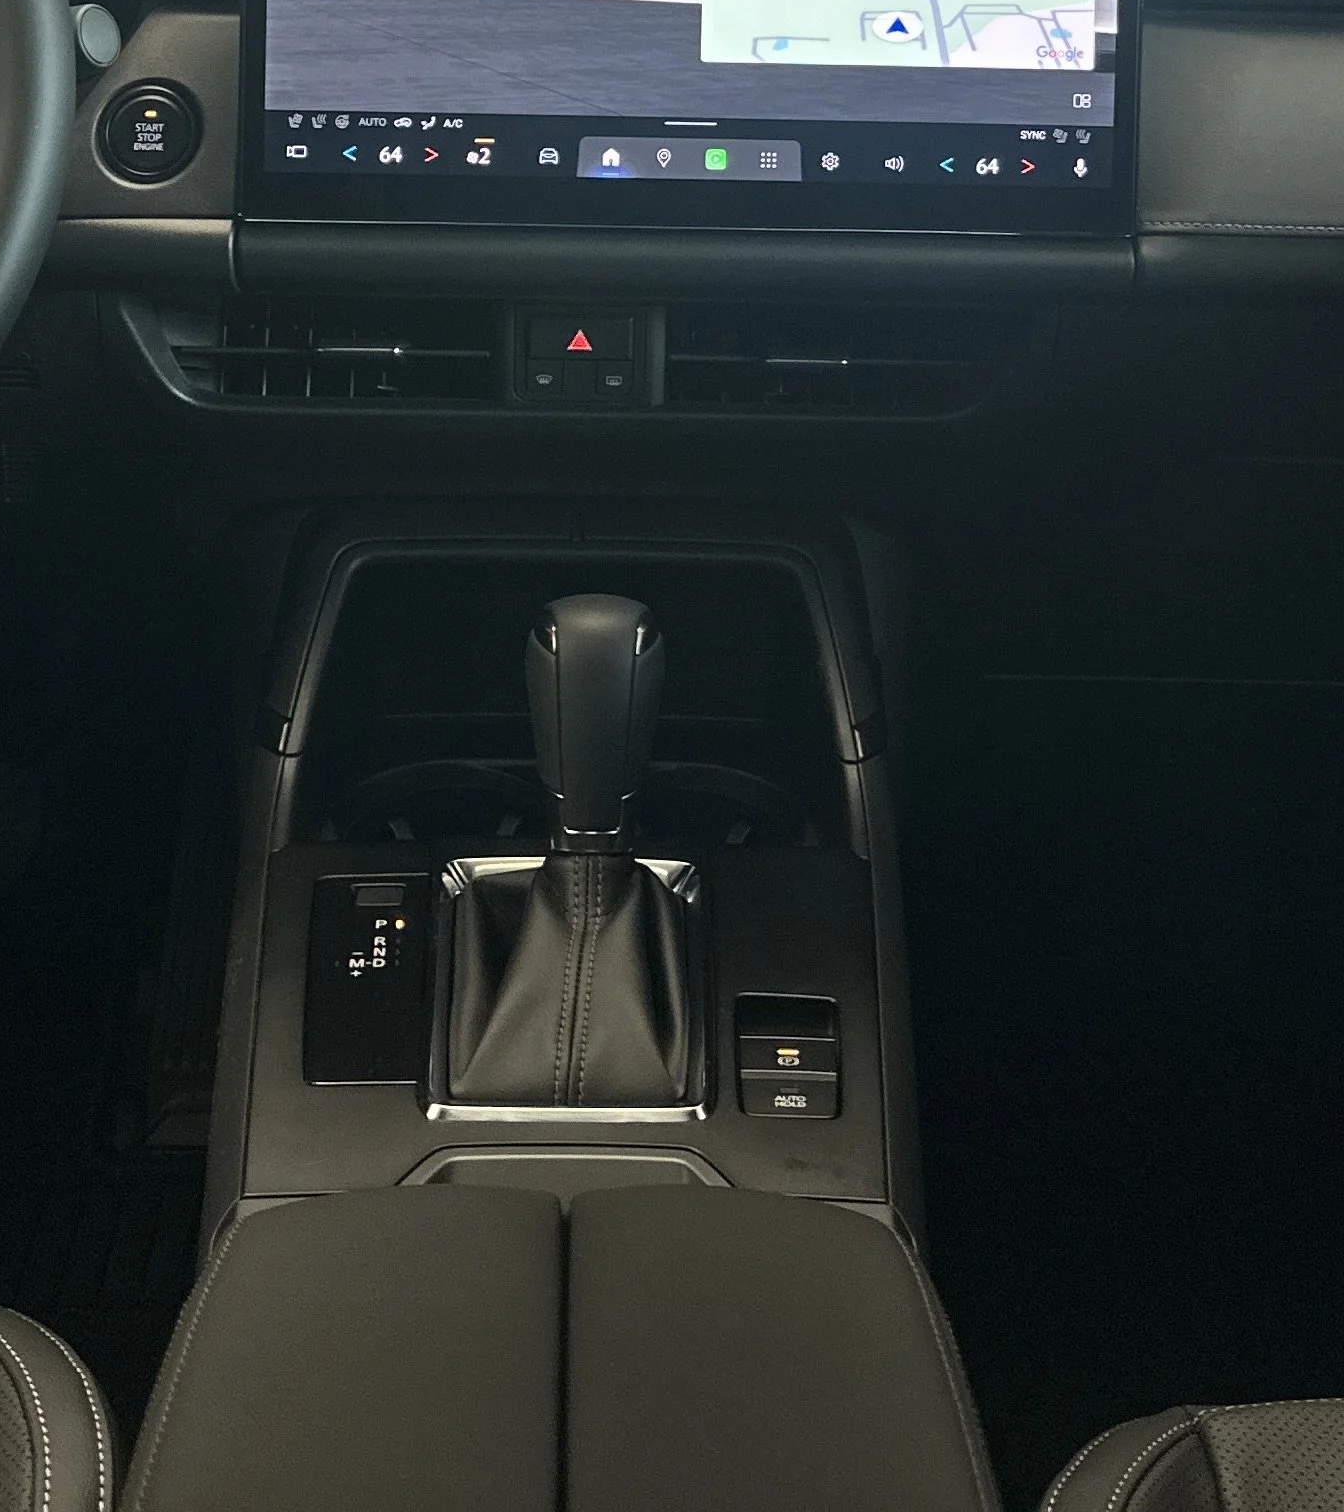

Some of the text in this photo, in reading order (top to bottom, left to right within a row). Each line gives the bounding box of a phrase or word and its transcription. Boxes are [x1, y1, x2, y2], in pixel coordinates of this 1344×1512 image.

[1036, 45, 1084, 61] Google
[359, 117, 387, 127] AUTO
[443, 118, 463, 129] A/C
[135, 122, 165, 133] START
[137, 132, 162, 142] STOP
[1020, 129, 1046, 141] SYNC
[133, 142, 164, 152] ENGINE
[379, 146, 403, 163] 64
[479, 148, 491, 164] 2
[976, 158, 999, 175] 64
[375, 919, 388, 929] P
[374, 936, 387, 946] R
[373, 947, 387, 957] N
[774, 1094, 807, 1102] AUTO
